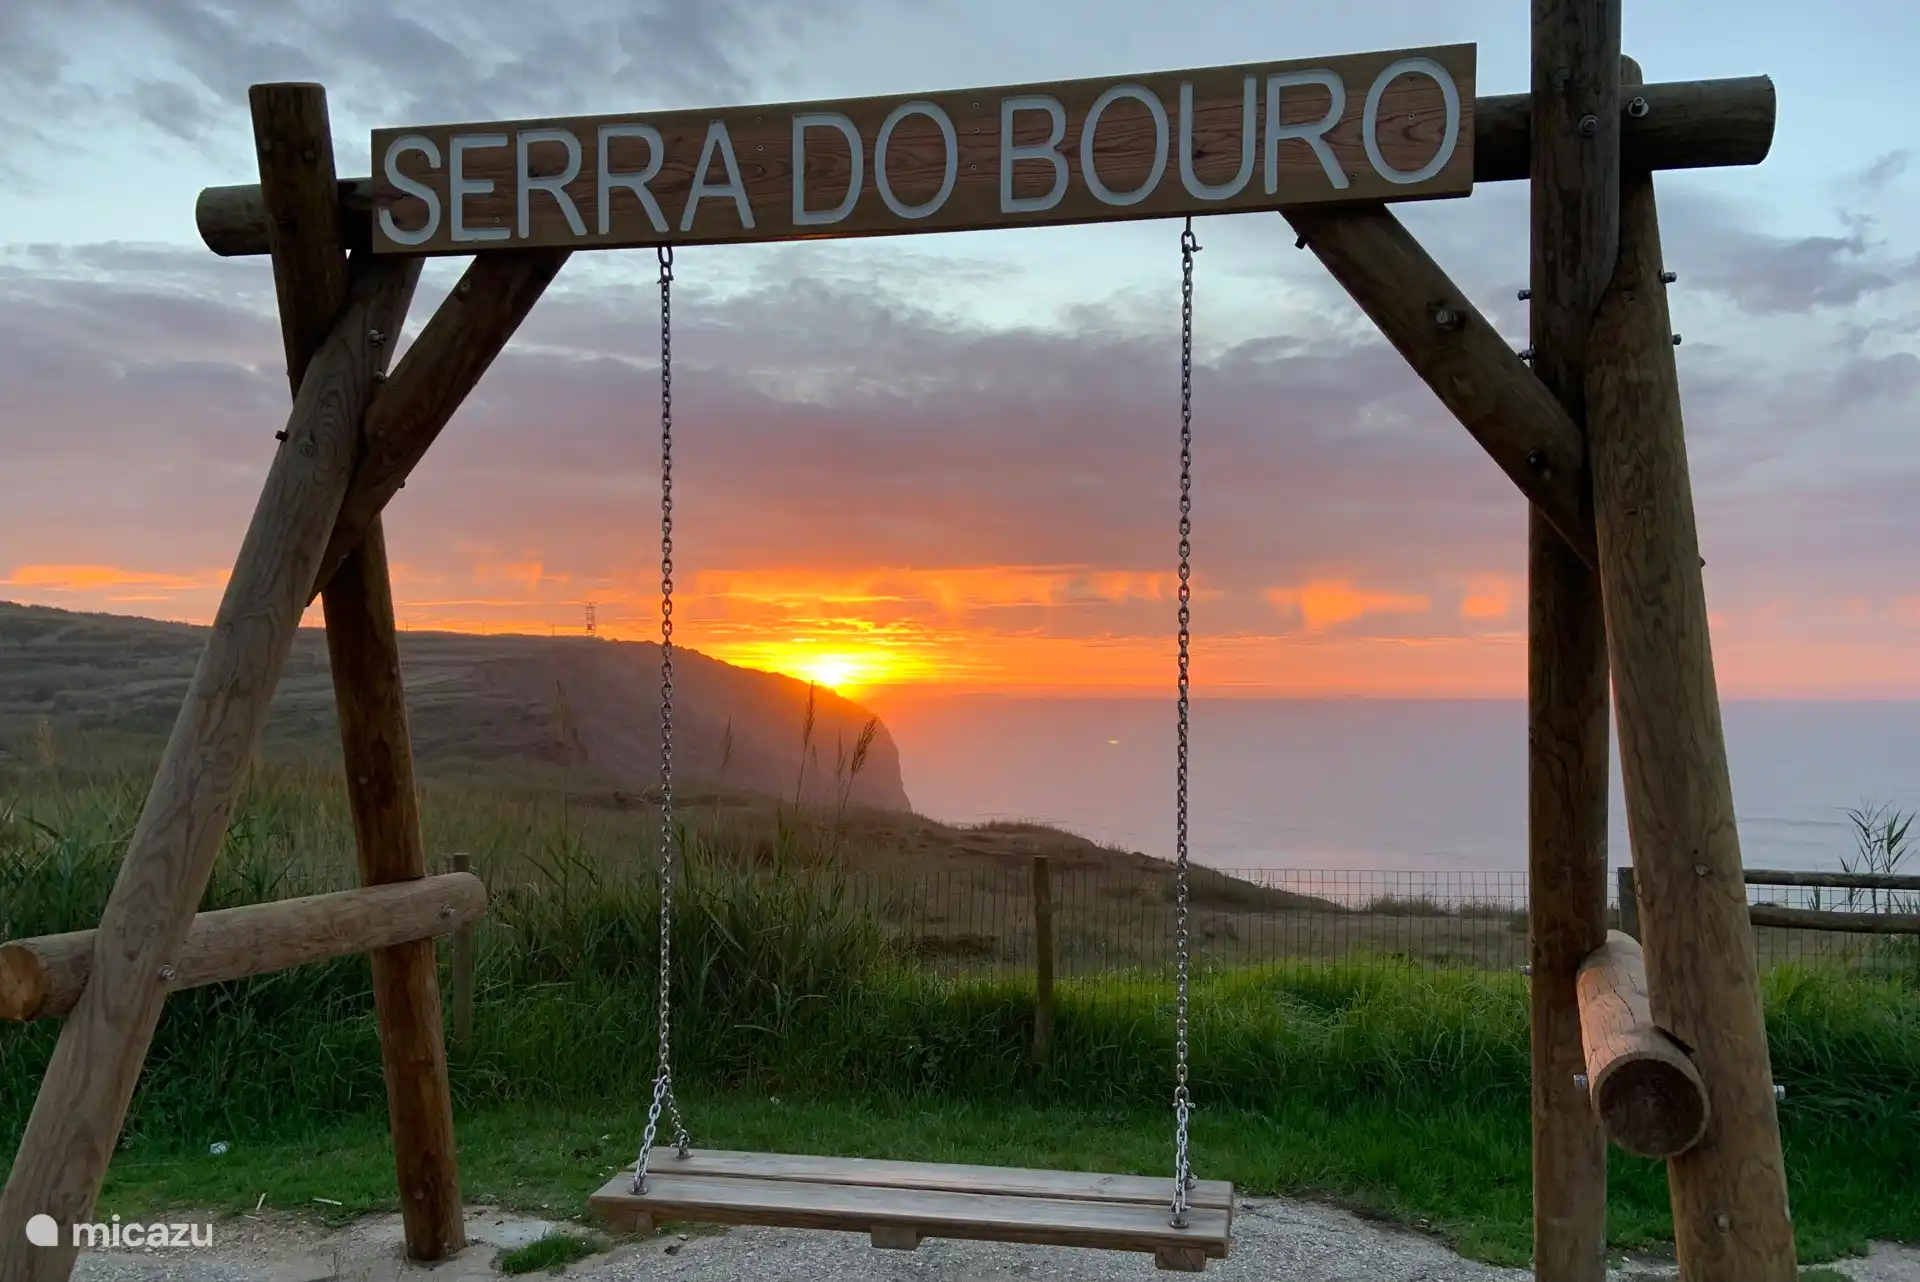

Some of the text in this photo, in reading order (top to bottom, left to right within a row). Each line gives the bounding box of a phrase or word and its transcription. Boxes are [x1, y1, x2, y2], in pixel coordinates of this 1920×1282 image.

[378, 56, 1461, 246] SERRA DO BOURO
